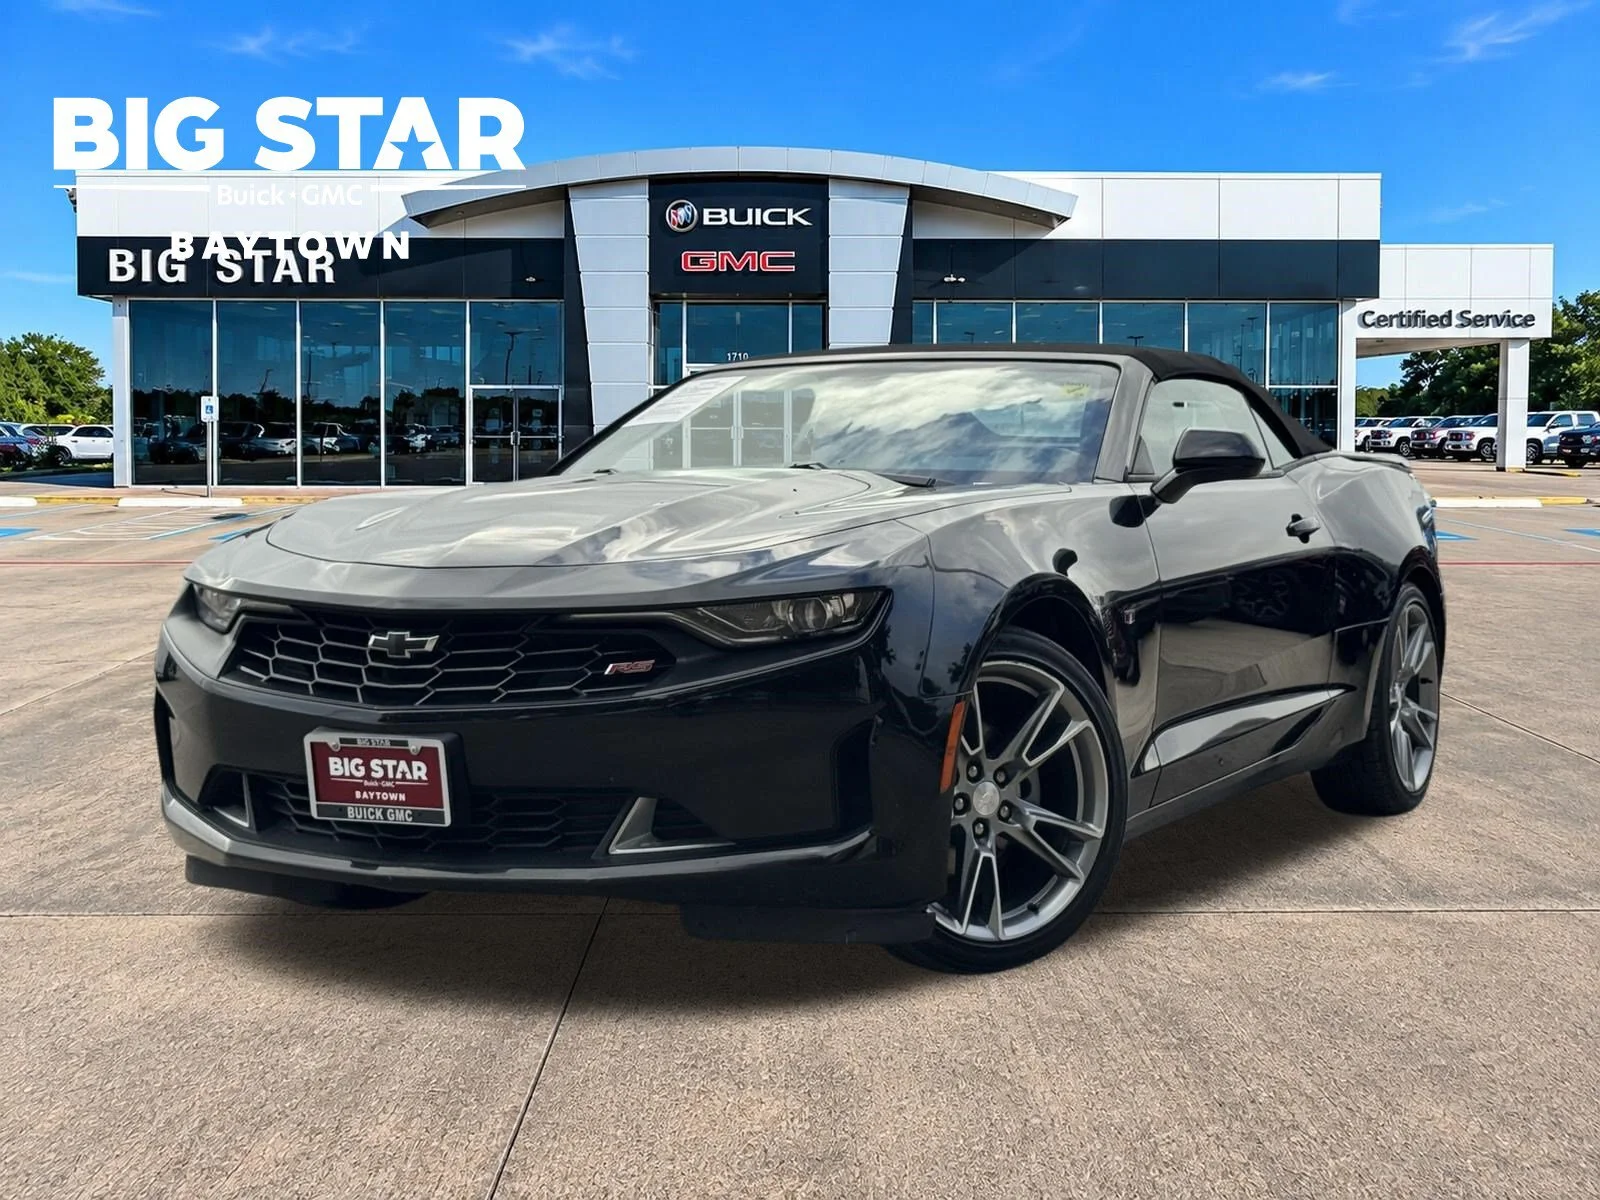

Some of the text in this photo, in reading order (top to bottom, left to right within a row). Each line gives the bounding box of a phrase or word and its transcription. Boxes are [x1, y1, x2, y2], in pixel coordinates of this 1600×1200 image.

[703, 207, 813, 226] BUICK
[108, 248, 336, 283] BIG STAR
[681, 251, 796, 272] GMC
[1360, 309, 1536, 328] Certified Service
[328, 756, 428, 781] BIG STAR
[355, 790, 406, 801] BAYTOWN
[347, 806, 413, 822] BUICK GMC
